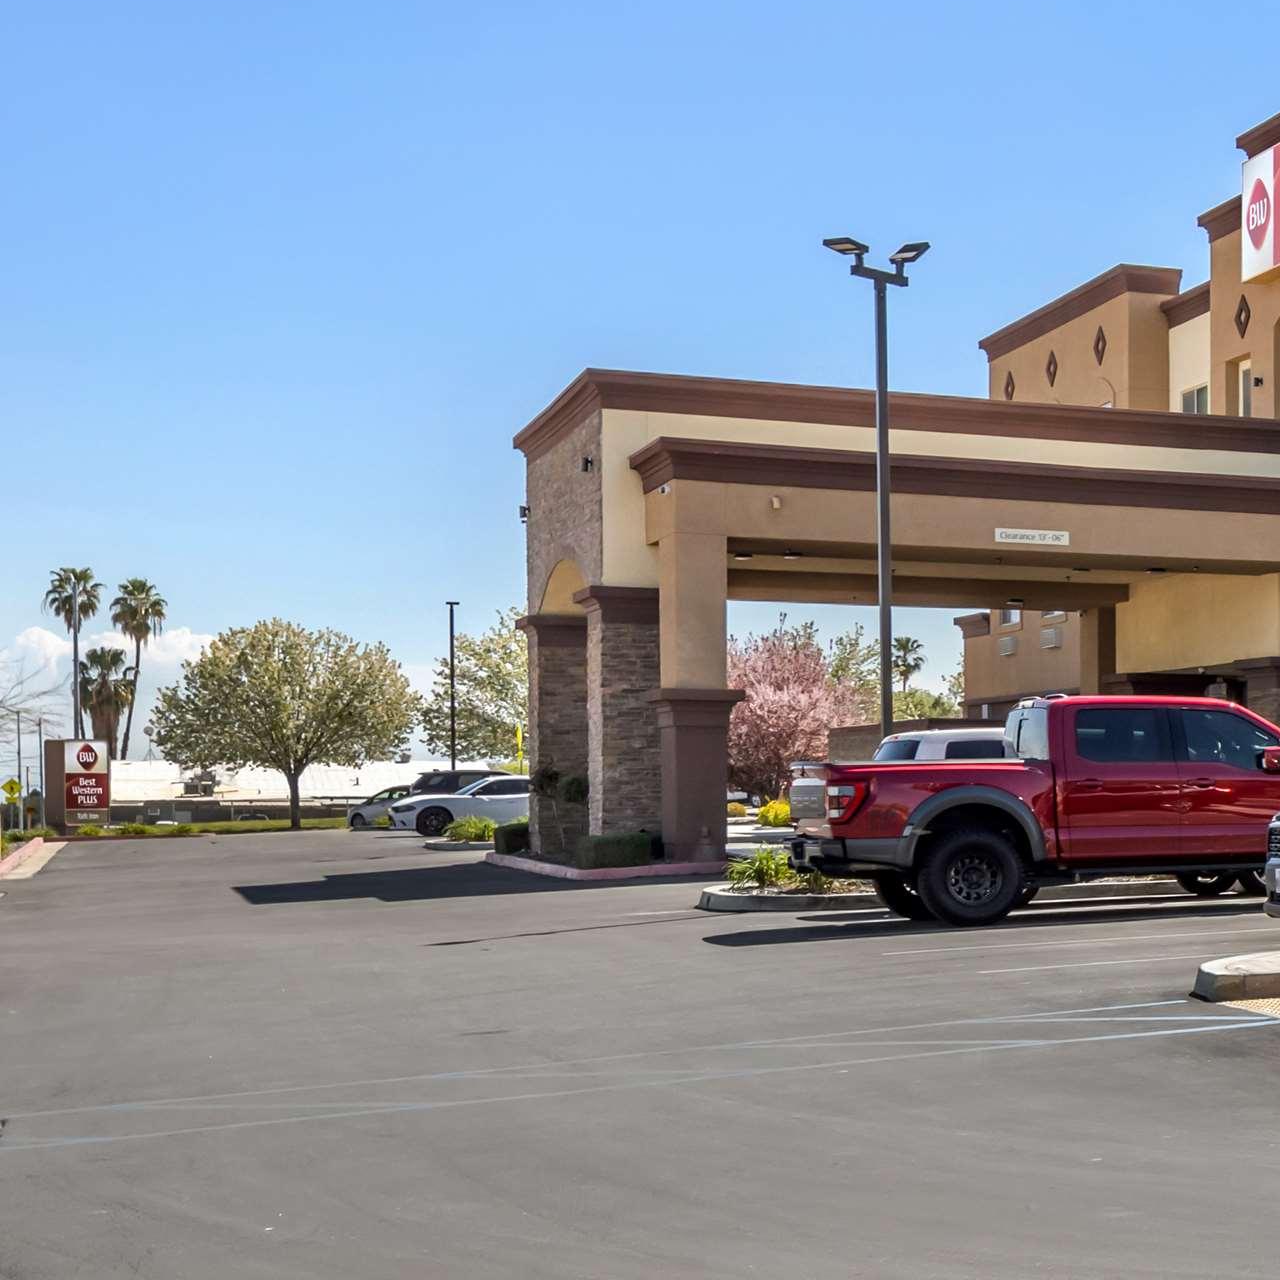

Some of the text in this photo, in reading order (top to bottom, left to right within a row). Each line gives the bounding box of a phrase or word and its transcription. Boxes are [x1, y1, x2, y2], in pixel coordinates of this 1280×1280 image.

[1249, 198, 1268, 231] BW
[1000, 531, 1037, 541] Clearance
[79, 751, 96, 763] BW
[79, 777, 96, 786] Best
[72, 785, 103, 795] Western
[77, 795, 98, 804] PLUS
